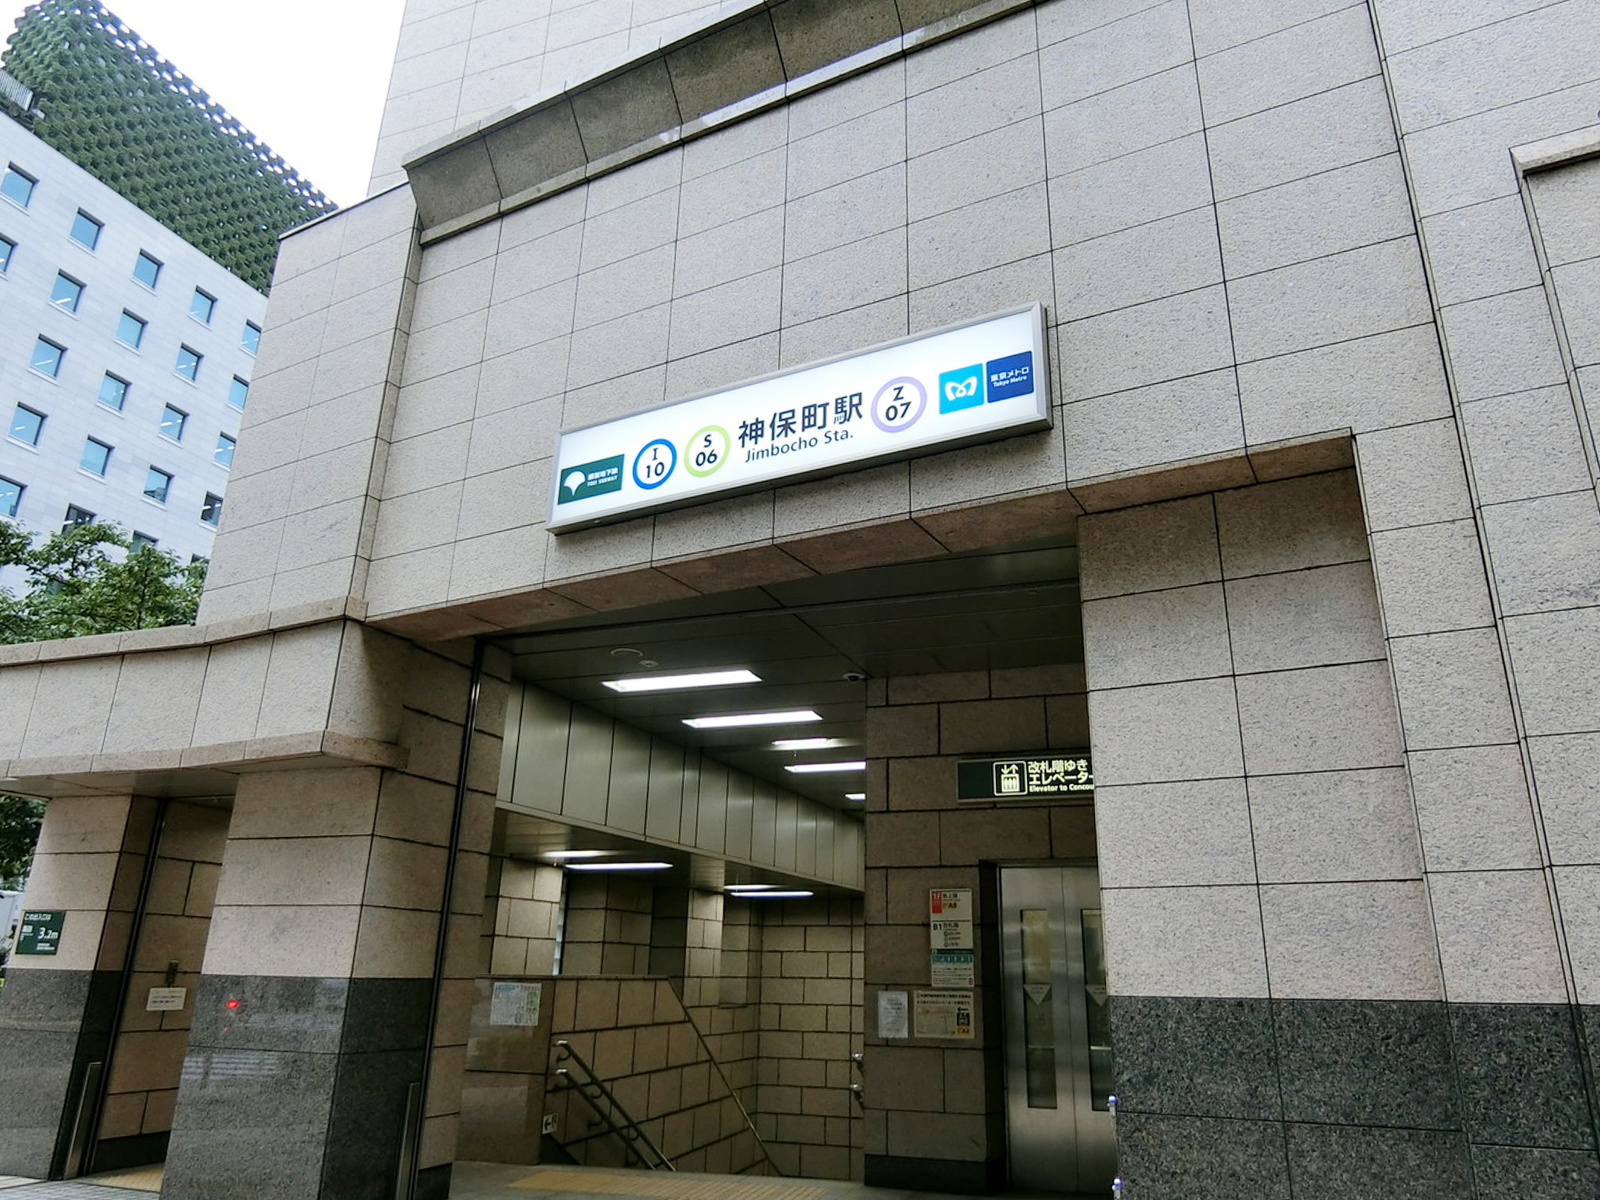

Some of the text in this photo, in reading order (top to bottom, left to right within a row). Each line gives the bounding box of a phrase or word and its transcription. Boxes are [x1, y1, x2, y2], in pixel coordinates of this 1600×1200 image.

[990, 366, 1029, 382] 東京メトロ
[993, 375, 1027, 387] Tokyo Metro
[893, 385, 904, 402] Z
[885, 401, 912, 422] 07
[738, 392, 863, 449] 神保町駅
[703, 434, 712, 448] S
[745, 429, 853, 463] Jimbocho Sta.
[695, 449, 718, 467] 06
[646, 461, 665, 479] 10
[1027, 758, 1088, 774] 改札階ゆき
[1068, 783, 1095, 791] Concou
[37, 927, 59, 940] 3.2m
